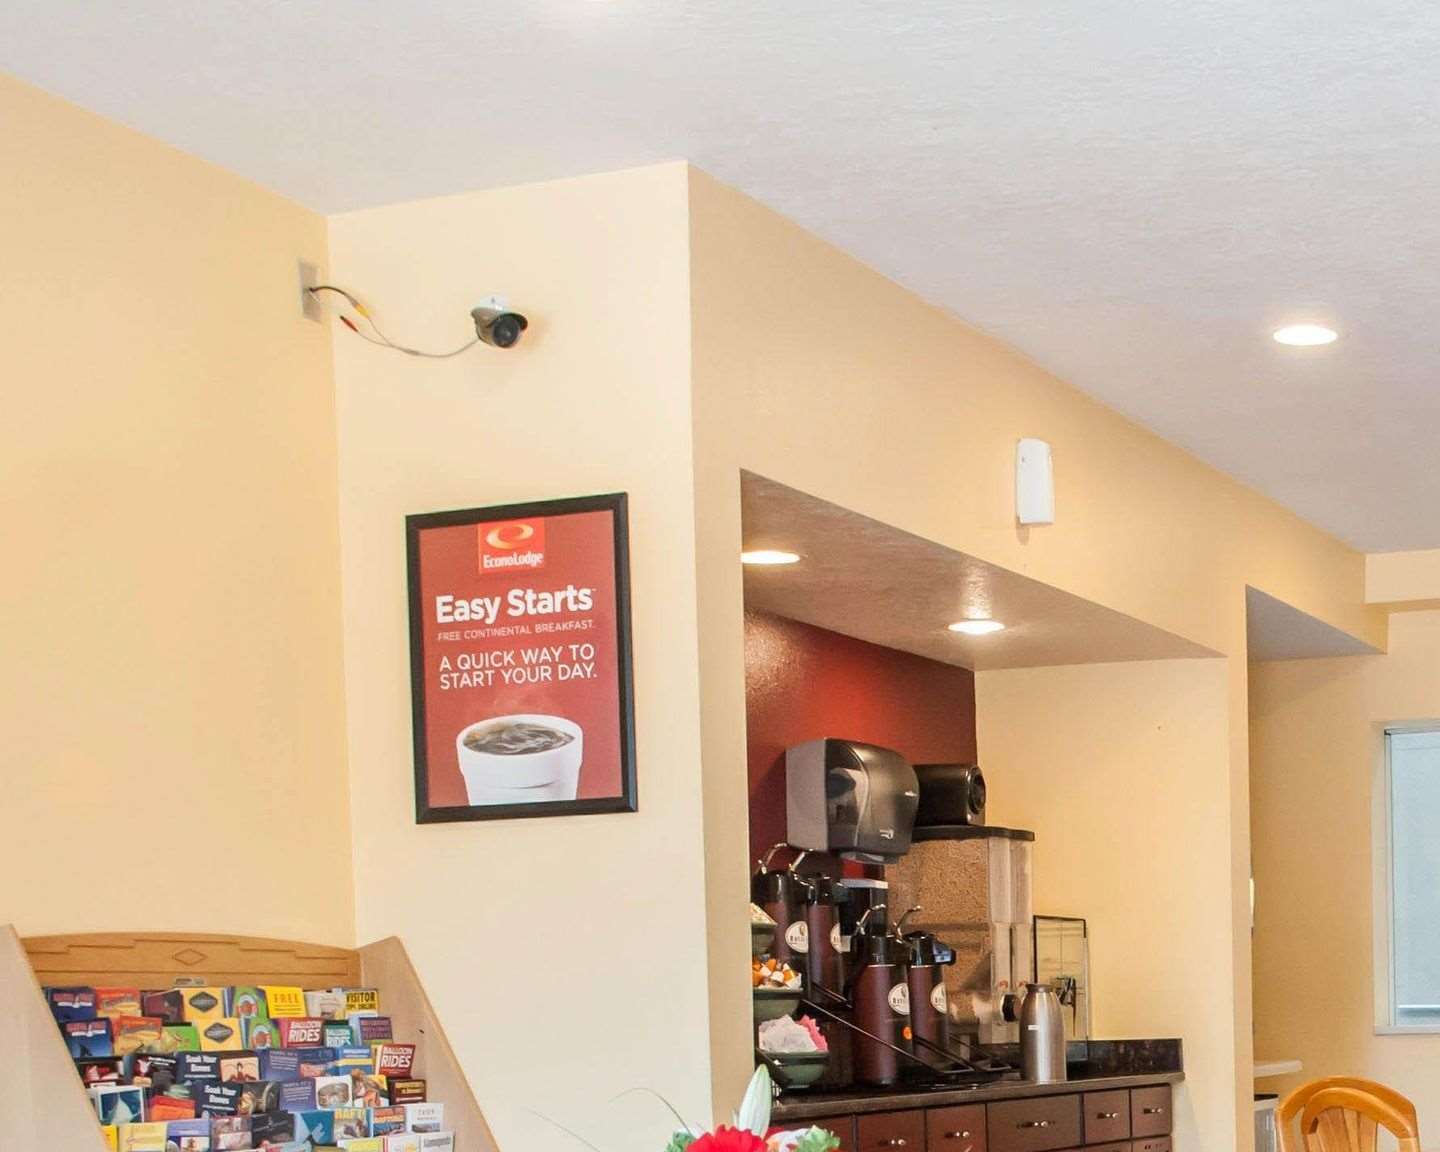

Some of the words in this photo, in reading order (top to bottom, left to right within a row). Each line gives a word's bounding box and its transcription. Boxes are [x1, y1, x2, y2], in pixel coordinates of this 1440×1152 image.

[436, 594, 501, 625] Easy
[507, 585, 593, 616] Starts
[438, 631, 461, 641] FREE
[464, 625, 532, 640] CONTINENTAL
[440, 656, 452, 672] A
[457, 650, 515, 670] QUICK
[520, 646, 563, 666] WAY
[568, 643, 595, 661] TO
[440, 669, 495, 690] START
[500, 666, 552, 685] YOUR
[558, 662, 598, 681] DAY.
[288, 1029, 320, 1042] RIDES
[381, 1056, 411, 1067] RIDES
